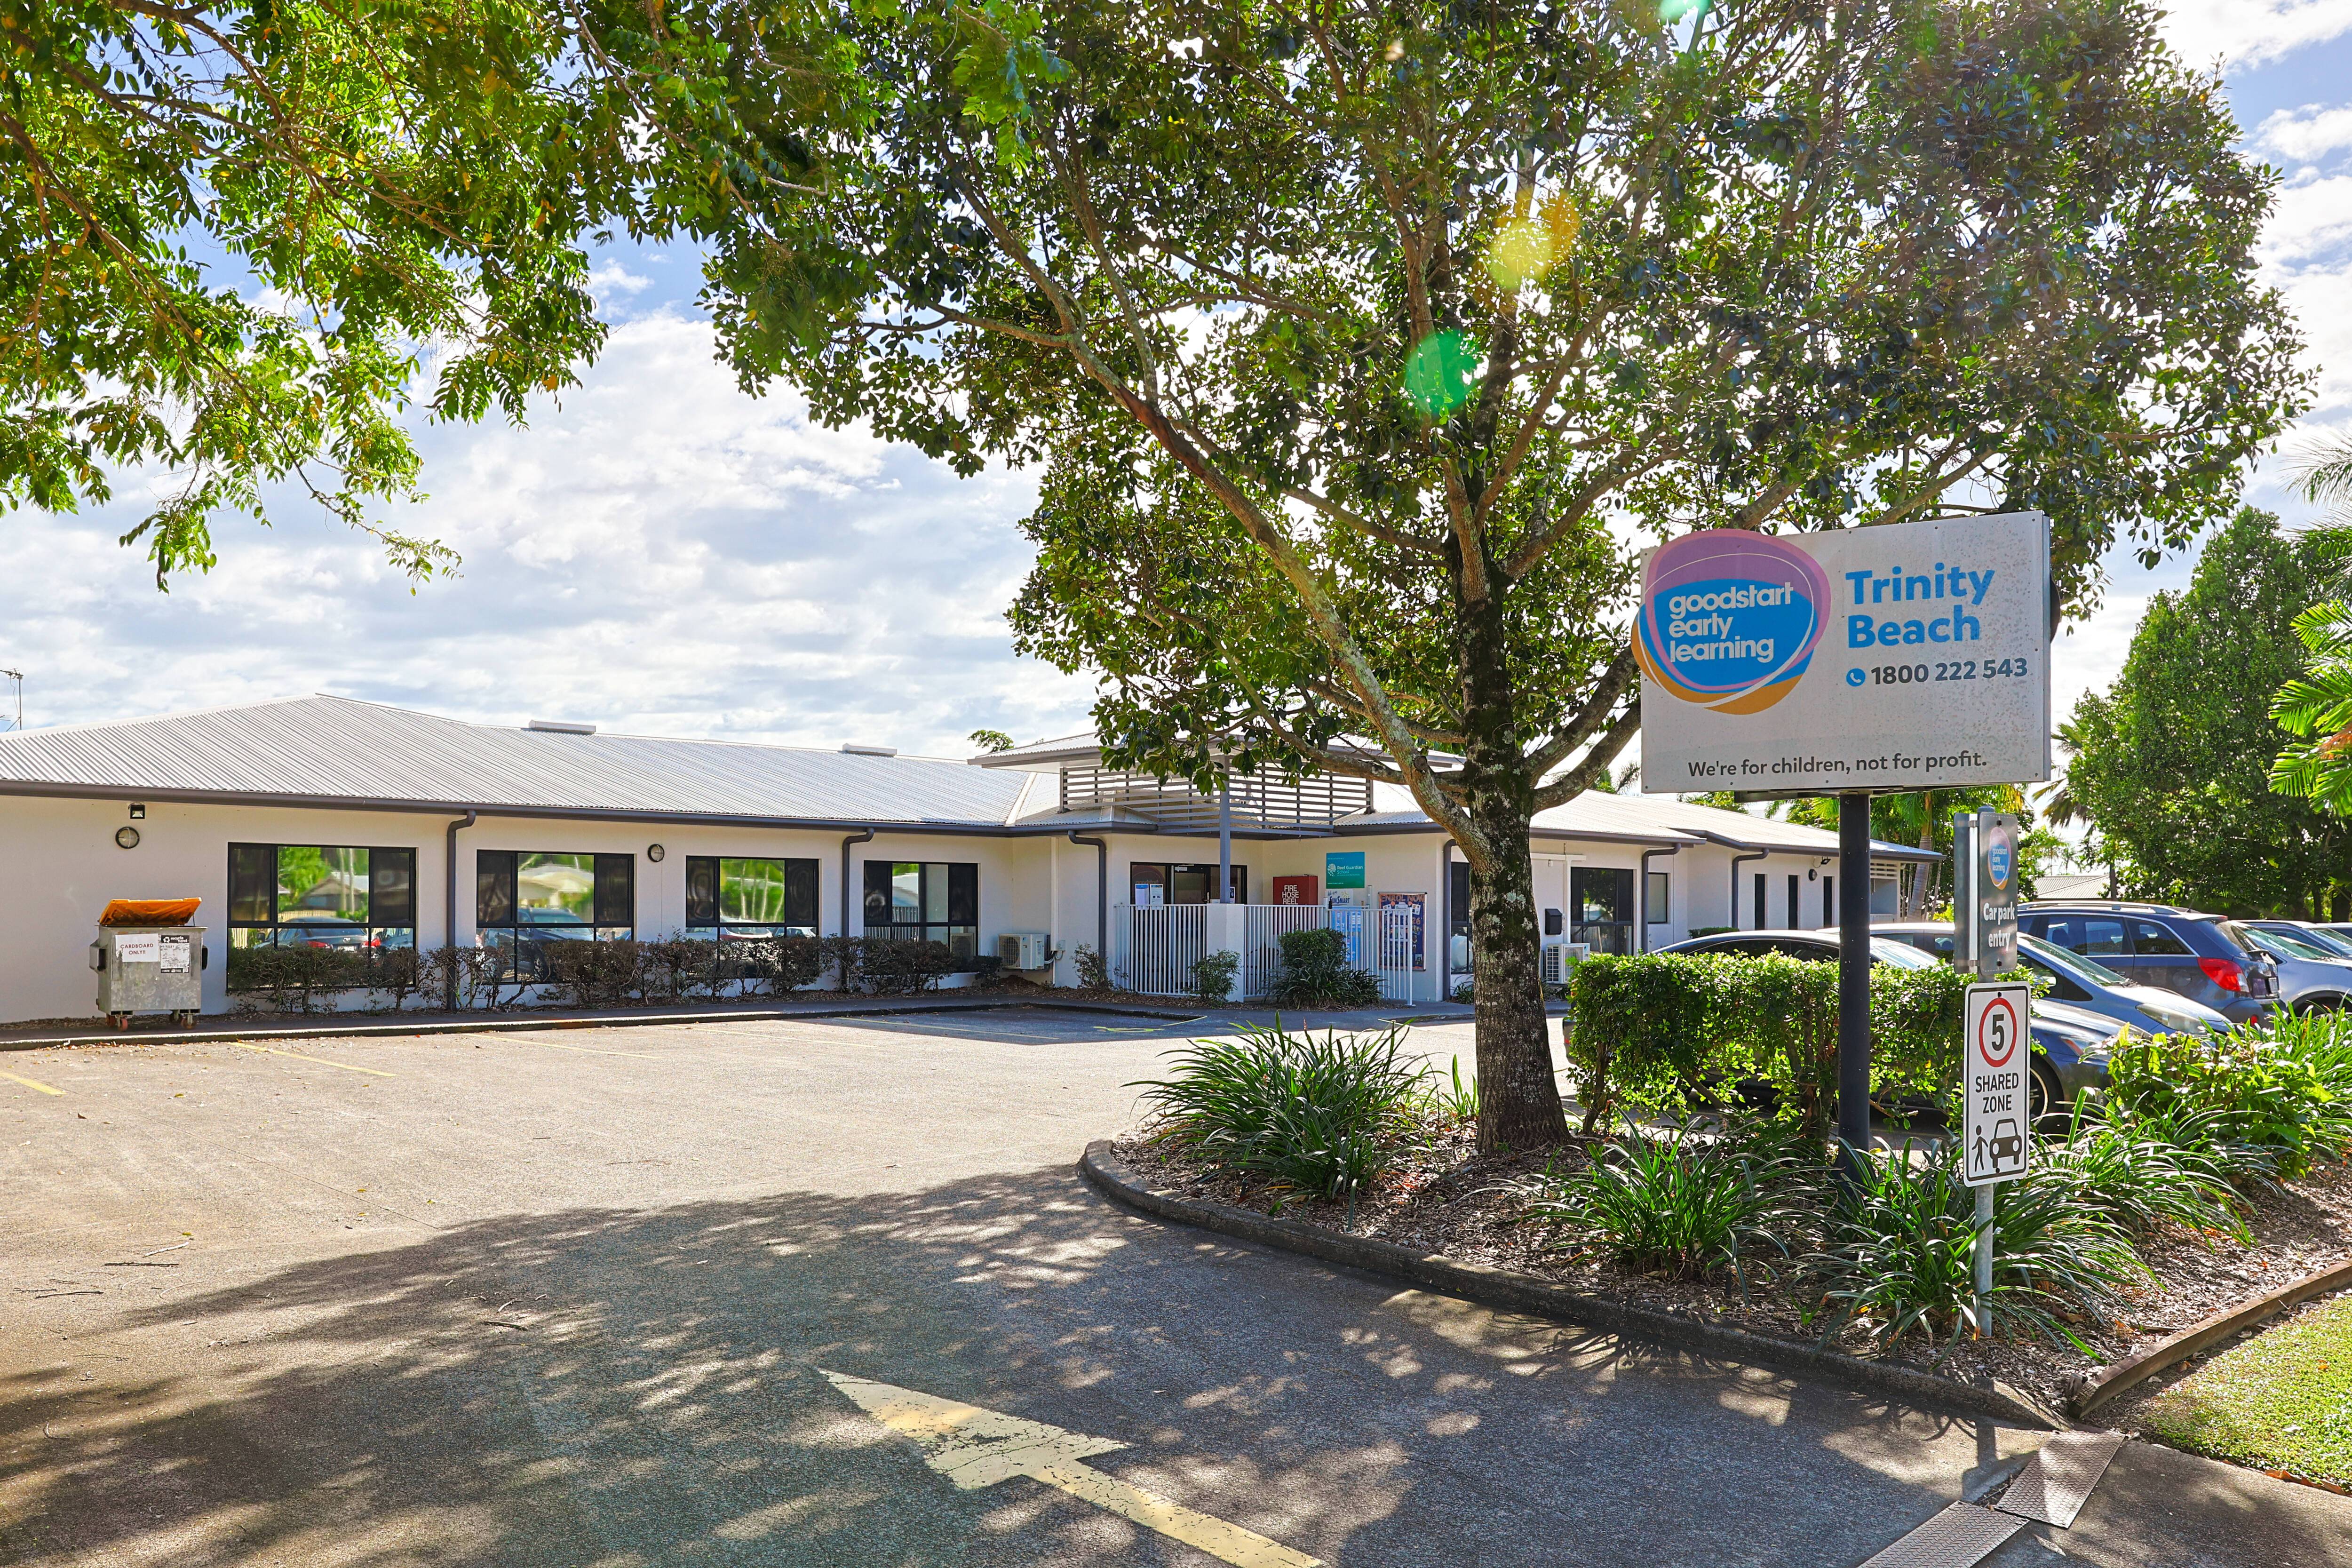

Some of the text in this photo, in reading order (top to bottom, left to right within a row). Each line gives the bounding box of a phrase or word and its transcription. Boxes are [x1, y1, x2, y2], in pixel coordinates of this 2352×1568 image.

[1845, 562, 1995, 605] Trinity
[1669, 582, 1794, 619] goodstart
[1669, 613, 1733, 639] early
[1848, 605, 1980, 648] Beach
[1670, 636, 1774, 663] learning
[1871, 658, 2028, 685] 1800 222 543
[1688, 750, 1987, 777] We're for children, not for profit.
[1992, 856, 2001, 864] early
[1993, 847, 2007, 856] goodstart
[1992, 864, 2005, 873] learning
[1983, 901, 2015, 925] Car park
[1988, 930, 2010, 951] entry
[1991, 1014, 2004, 1051] 5
[1975, 1072, 2019, 1093] SHARED
[1983, 1094, 2012, 1114] ZONE
